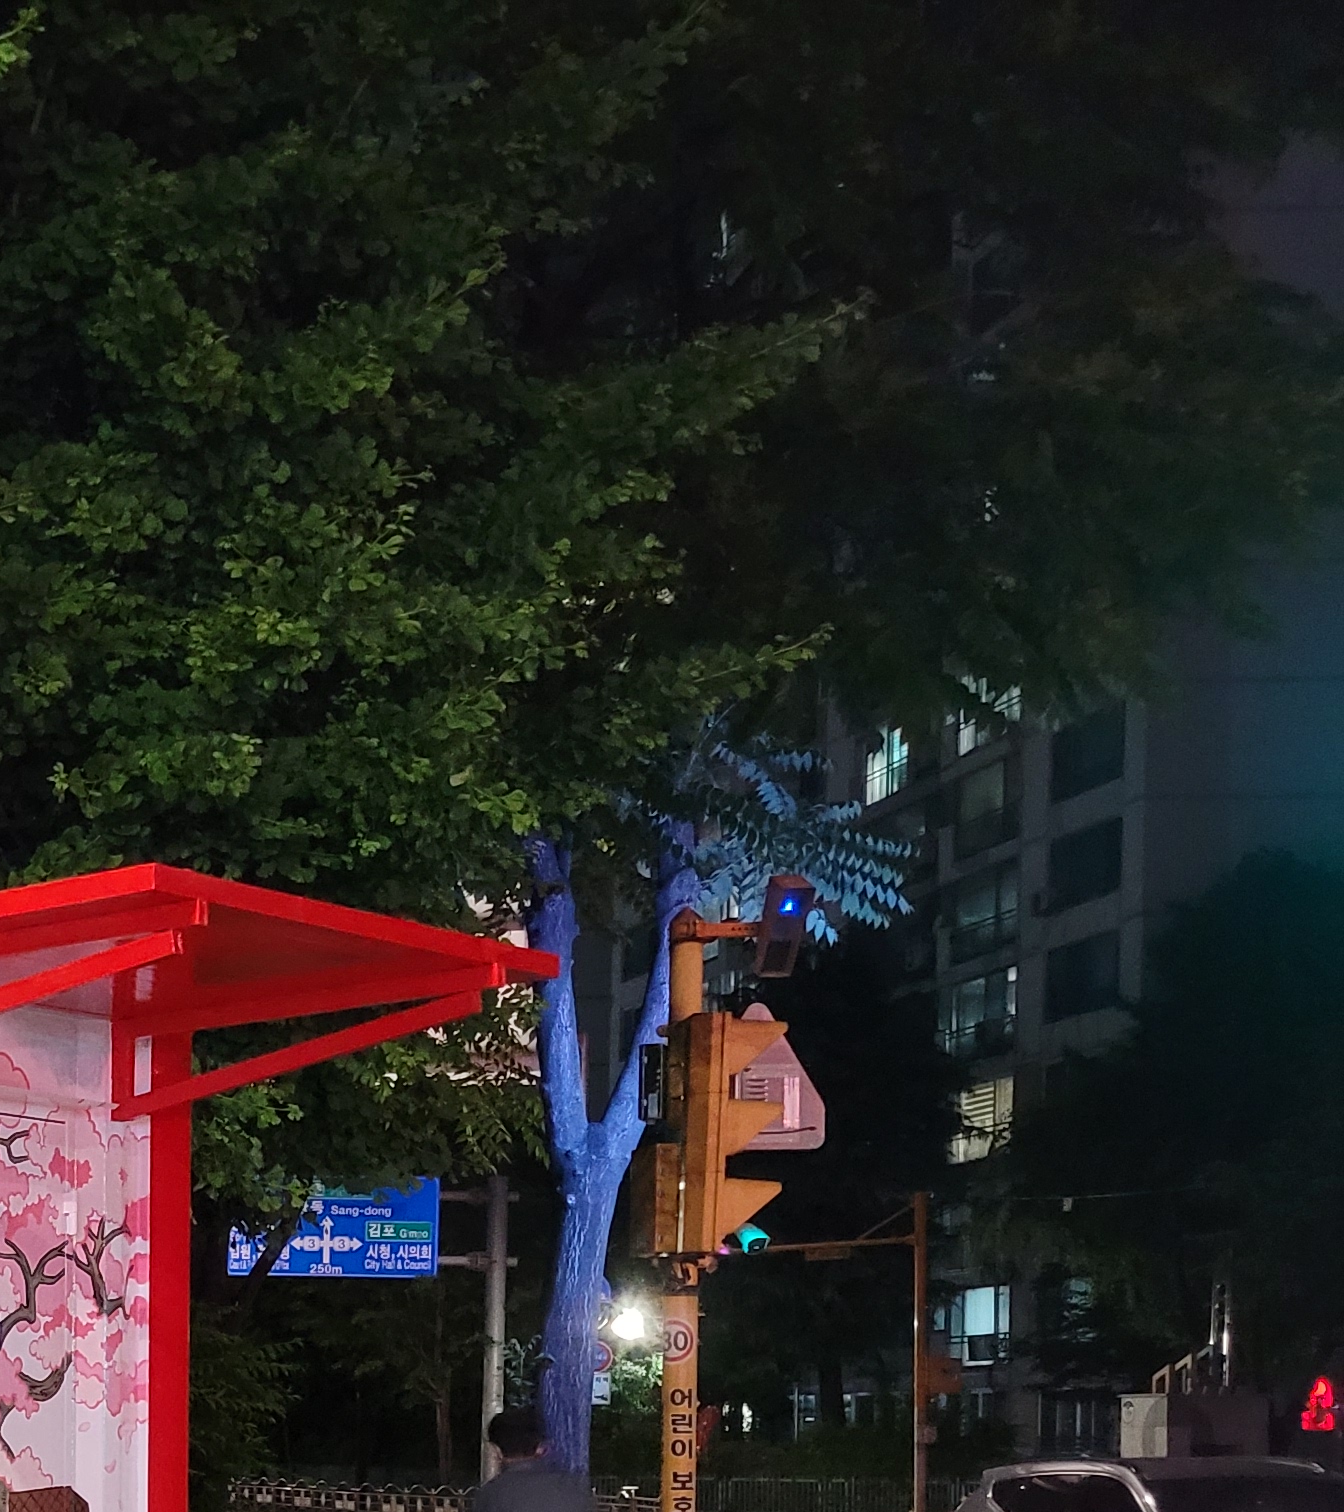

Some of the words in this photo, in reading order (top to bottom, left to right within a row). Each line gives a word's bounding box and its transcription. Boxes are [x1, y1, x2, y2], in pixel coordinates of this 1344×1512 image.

[330, 1204, 392, 1218] Sang-dong
[368, 1223, 396, 1238] 김포
[308, 1238, 316, 1250] 3
[338, 1238, 346, 1250] 3
[309, 1263, 343, 1275] 250m
[365, 1259, 380, 1272] City
[669, 1388, 694, 1460] 어린이
